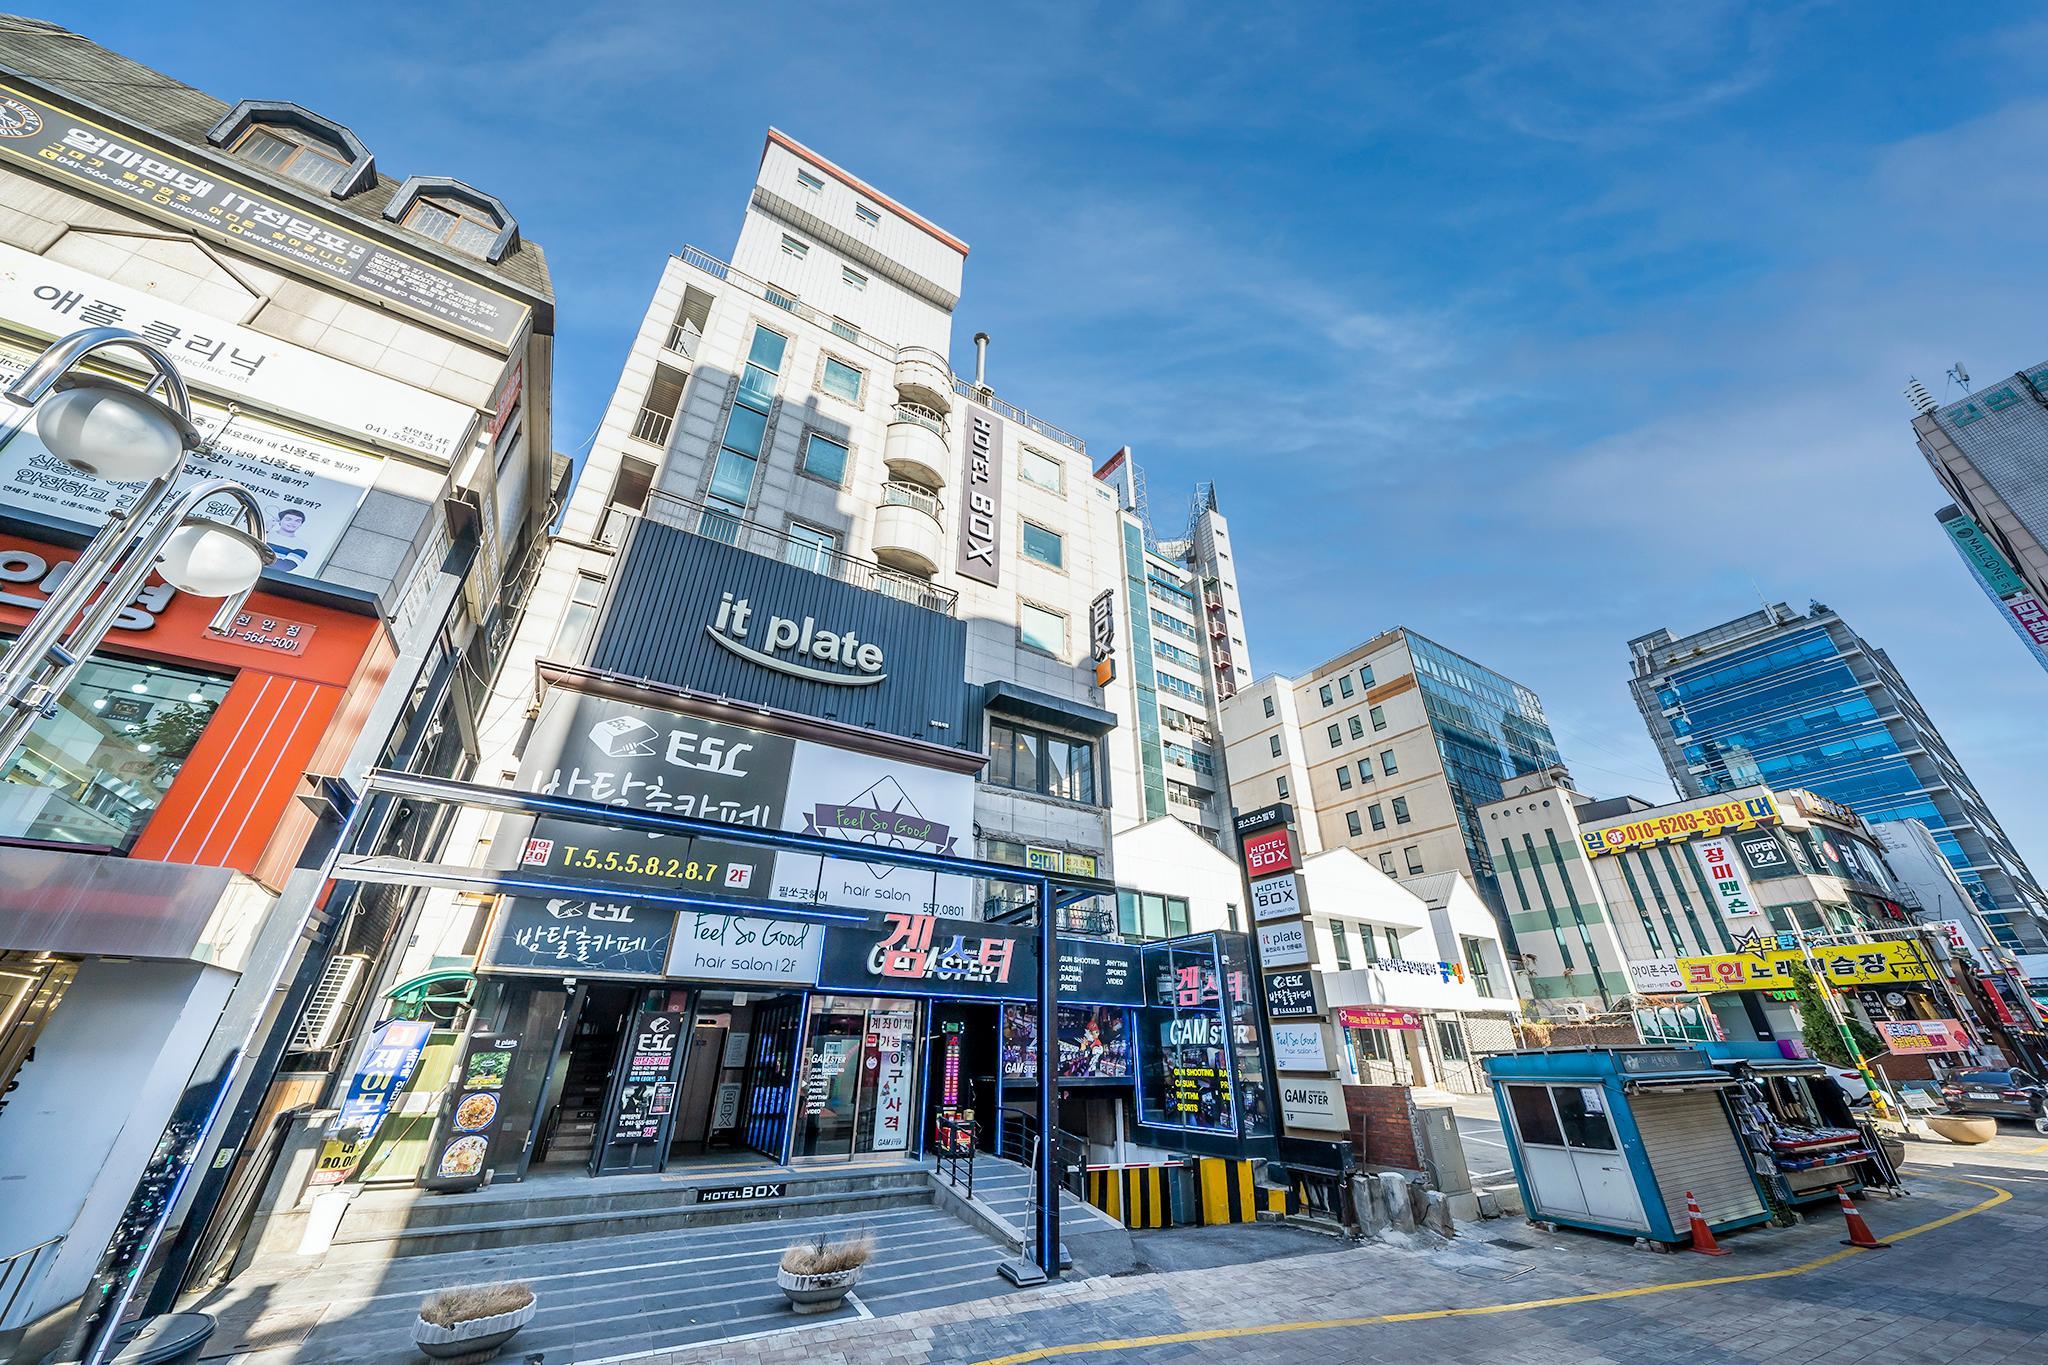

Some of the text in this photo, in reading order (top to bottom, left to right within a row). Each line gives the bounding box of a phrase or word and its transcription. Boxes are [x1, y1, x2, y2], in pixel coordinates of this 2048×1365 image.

[62, 128, 215, 198] 얼마면돼
[220, 192, 350, 254] IT전당포
[169, 200, 221, 226] unclebin
[243, 230, 352, 277] www.unclebin.co.kr
[33, 285, 266, 377] 애플 클리닉
[364, 422, 447, 455] 041.555.5311
[437, 437, 452, 447] 4F
[14, 468, 111, 502] 안전하고
[235, 463, 268, 478] 가지는
[271, 472, 309, 489] 않을까?
[283, 491, 323, 511] 않을까?
[966, 416, 995, 569] HOTEL BOX
[1968, 536, 2008, 580] NAILZONE
[713, 591, 885, 674] it plate
[1093, 596, 1115, 661] BOX
[664, 729, 754, 778] ESC
[835, 807, 932, 840] Feel So Good
[1608, 832, 1624, 844] 3F
[1626, 804, 1746, 842] 010-6203-3613
[1745, 796, 1775, 817] 대
[1250, 839, 1286, 854] HOTEL
[1251, 848, 1289, 868] BOX
[1745, 840, 1777, 854] OPEN
[1754, 850, 1778, 864] 24
[562, 845, 718, 882] T.5.5.5.8.2.8.7
[728, 867, 749, 884] 2F
[842, 881, 912, 902] hair salon
[1256, 879, 1293, 893] HOTEL
[922, 902, 965, 916] 557.0801
[1258, 889, 1295, 907] BOX
[693, 911, 811, 951] Feel So Good
[1262, 929, 1302, 946] it plate
[514, 925, 650, 962] 방탈출카페
[876, 912, 1016, 984] 겜스터
[694, 952, 727, 969] hair
[731, 957, 773, 972] salon
[1073, 956, 1101, 966] SHOOTING
[1631, 963, 1680, 978] 아이폰수리
[1689, 960, 1746, 985] 코인
[1175, 965, 1244, 1006] 겜스터
[1285, 974, 1304, 987] ESC
[637, 1033, 677, 1051] ESC
[880, 1035, 902, 1048] 가능
[1300, 1032, 1318, 1046] Good
[1186, 1068, 1215, 1077] SHOOTING
[718, 1090, 737, 1127] BOX
[1286, 1113, 1294, 1122] 1F
